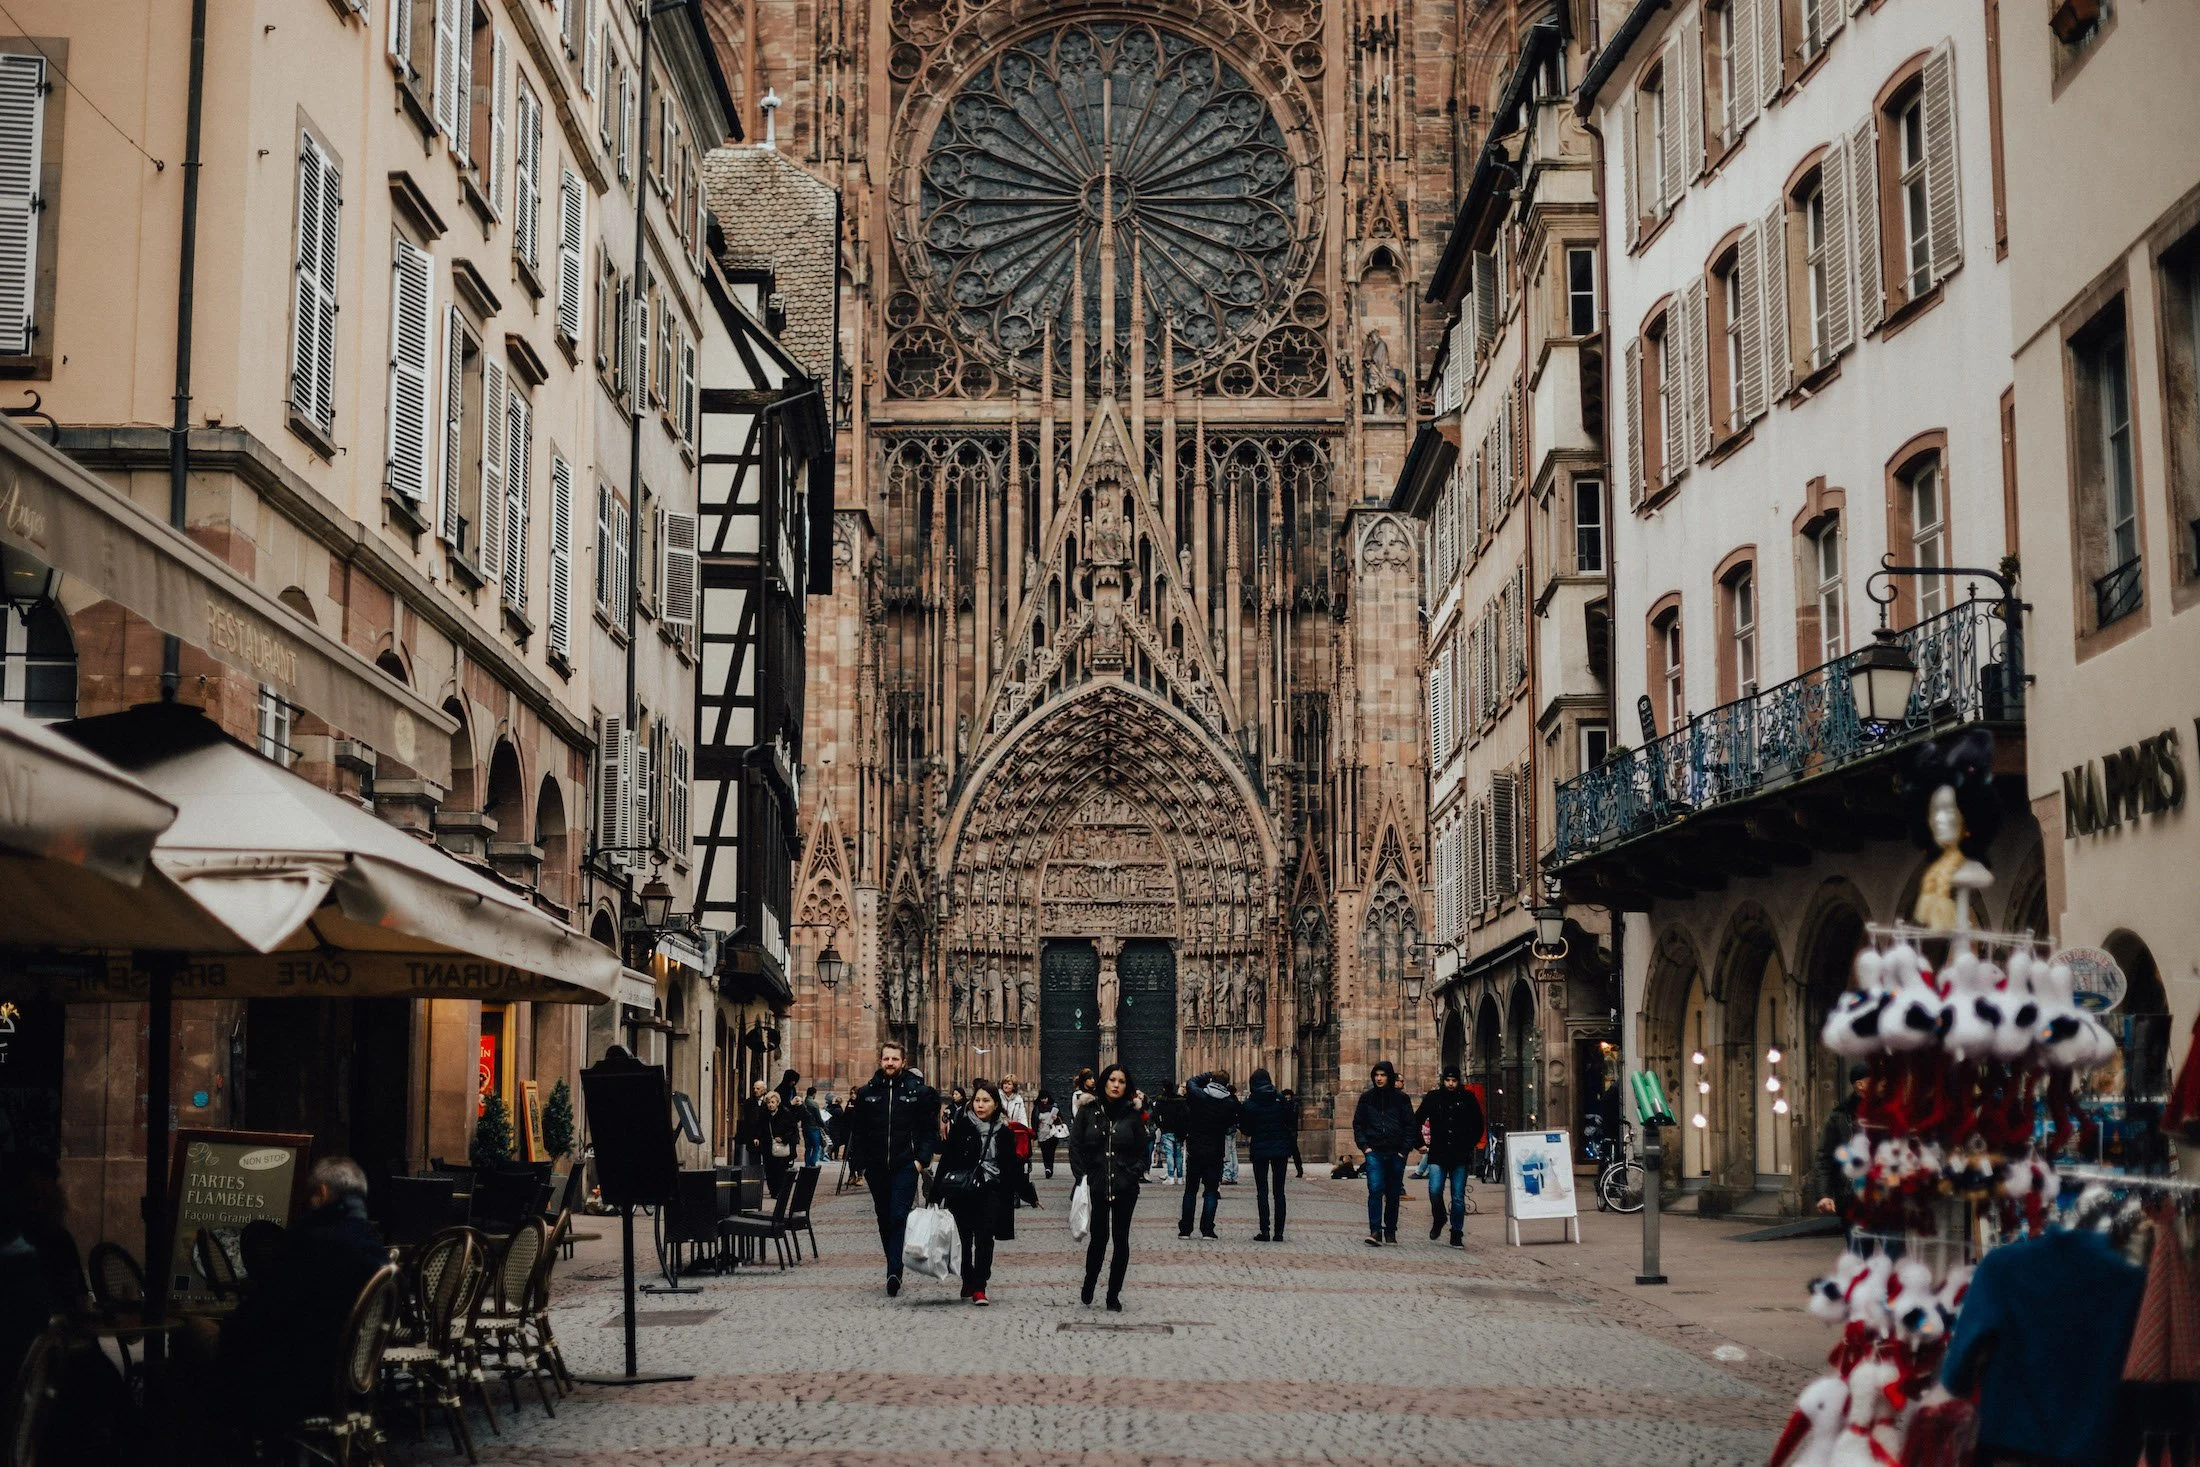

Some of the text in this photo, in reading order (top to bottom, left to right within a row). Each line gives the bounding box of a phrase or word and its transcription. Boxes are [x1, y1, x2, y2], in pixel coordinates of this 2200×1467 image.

[206, 599, 298, 688] RESTAURANT
[242, 1153, 286, 1167] NON STOP
[190, 1173, 245, 1190] TARTES
[186, 1190, 265, 1209] FLAMBÉES
[184, 1209, 215, 1223] Façon
[219, 1211, 252, 1224] Grand
